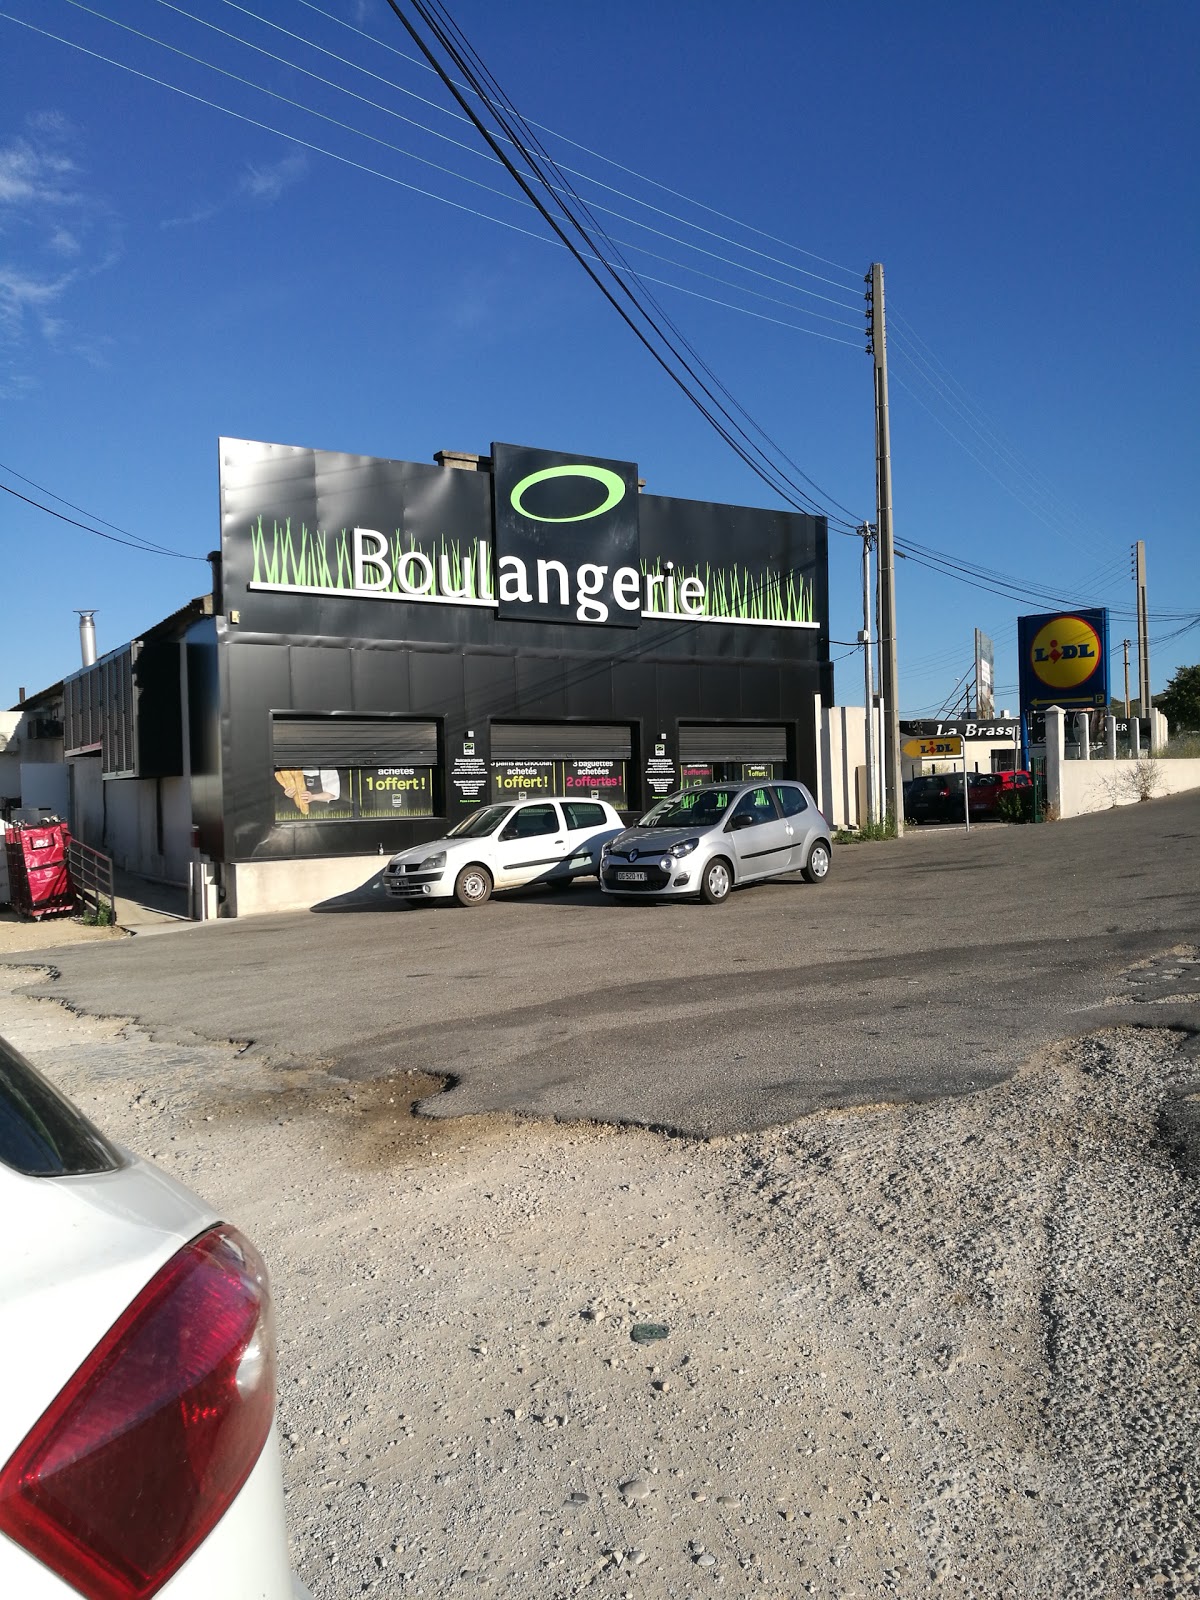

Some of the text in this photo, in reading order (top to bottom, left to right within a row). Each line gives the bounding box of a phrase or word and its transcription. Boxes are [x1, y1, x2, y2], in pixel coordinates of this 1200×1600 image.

[351, 527, 706, 622] Boulangerie
[936, 724, 958, 735] La
[506, 767, 538, 775] achetés
[577, 767, 610, 776] achetées
